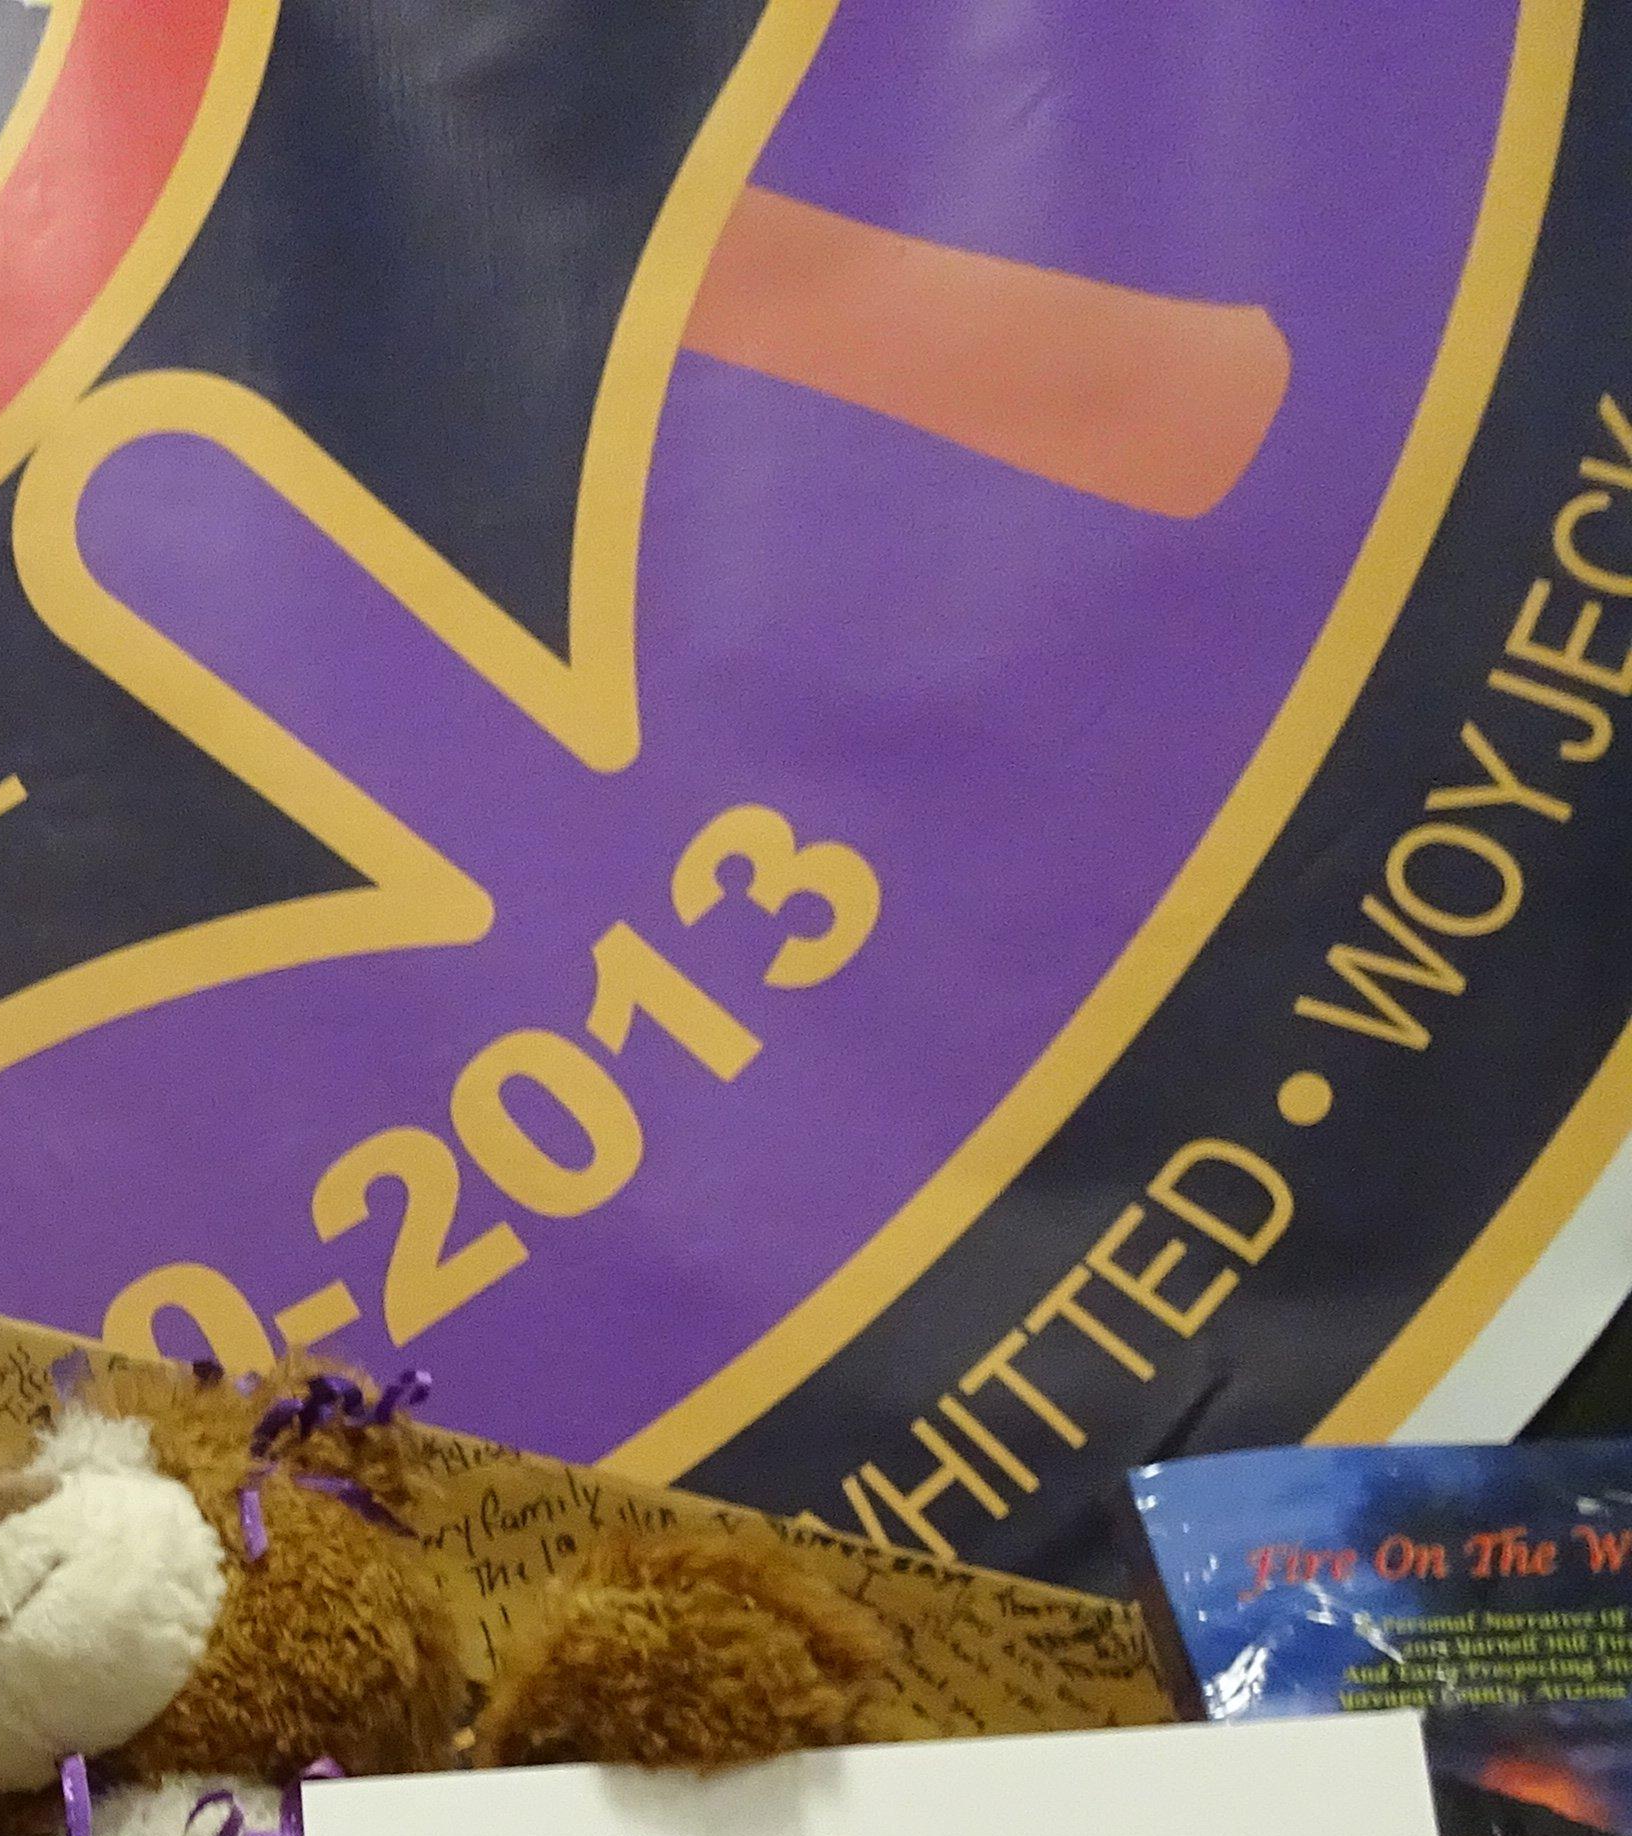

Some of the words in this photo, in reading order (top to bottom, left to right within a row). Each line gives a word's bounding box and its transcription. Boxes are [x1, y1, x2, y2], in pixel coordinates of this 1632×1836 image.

[1236, 1539, 1358, 1605] Fire
[1373, 1533, 1449, 1582] On
[1463, 1526, 1559, 1578] The
